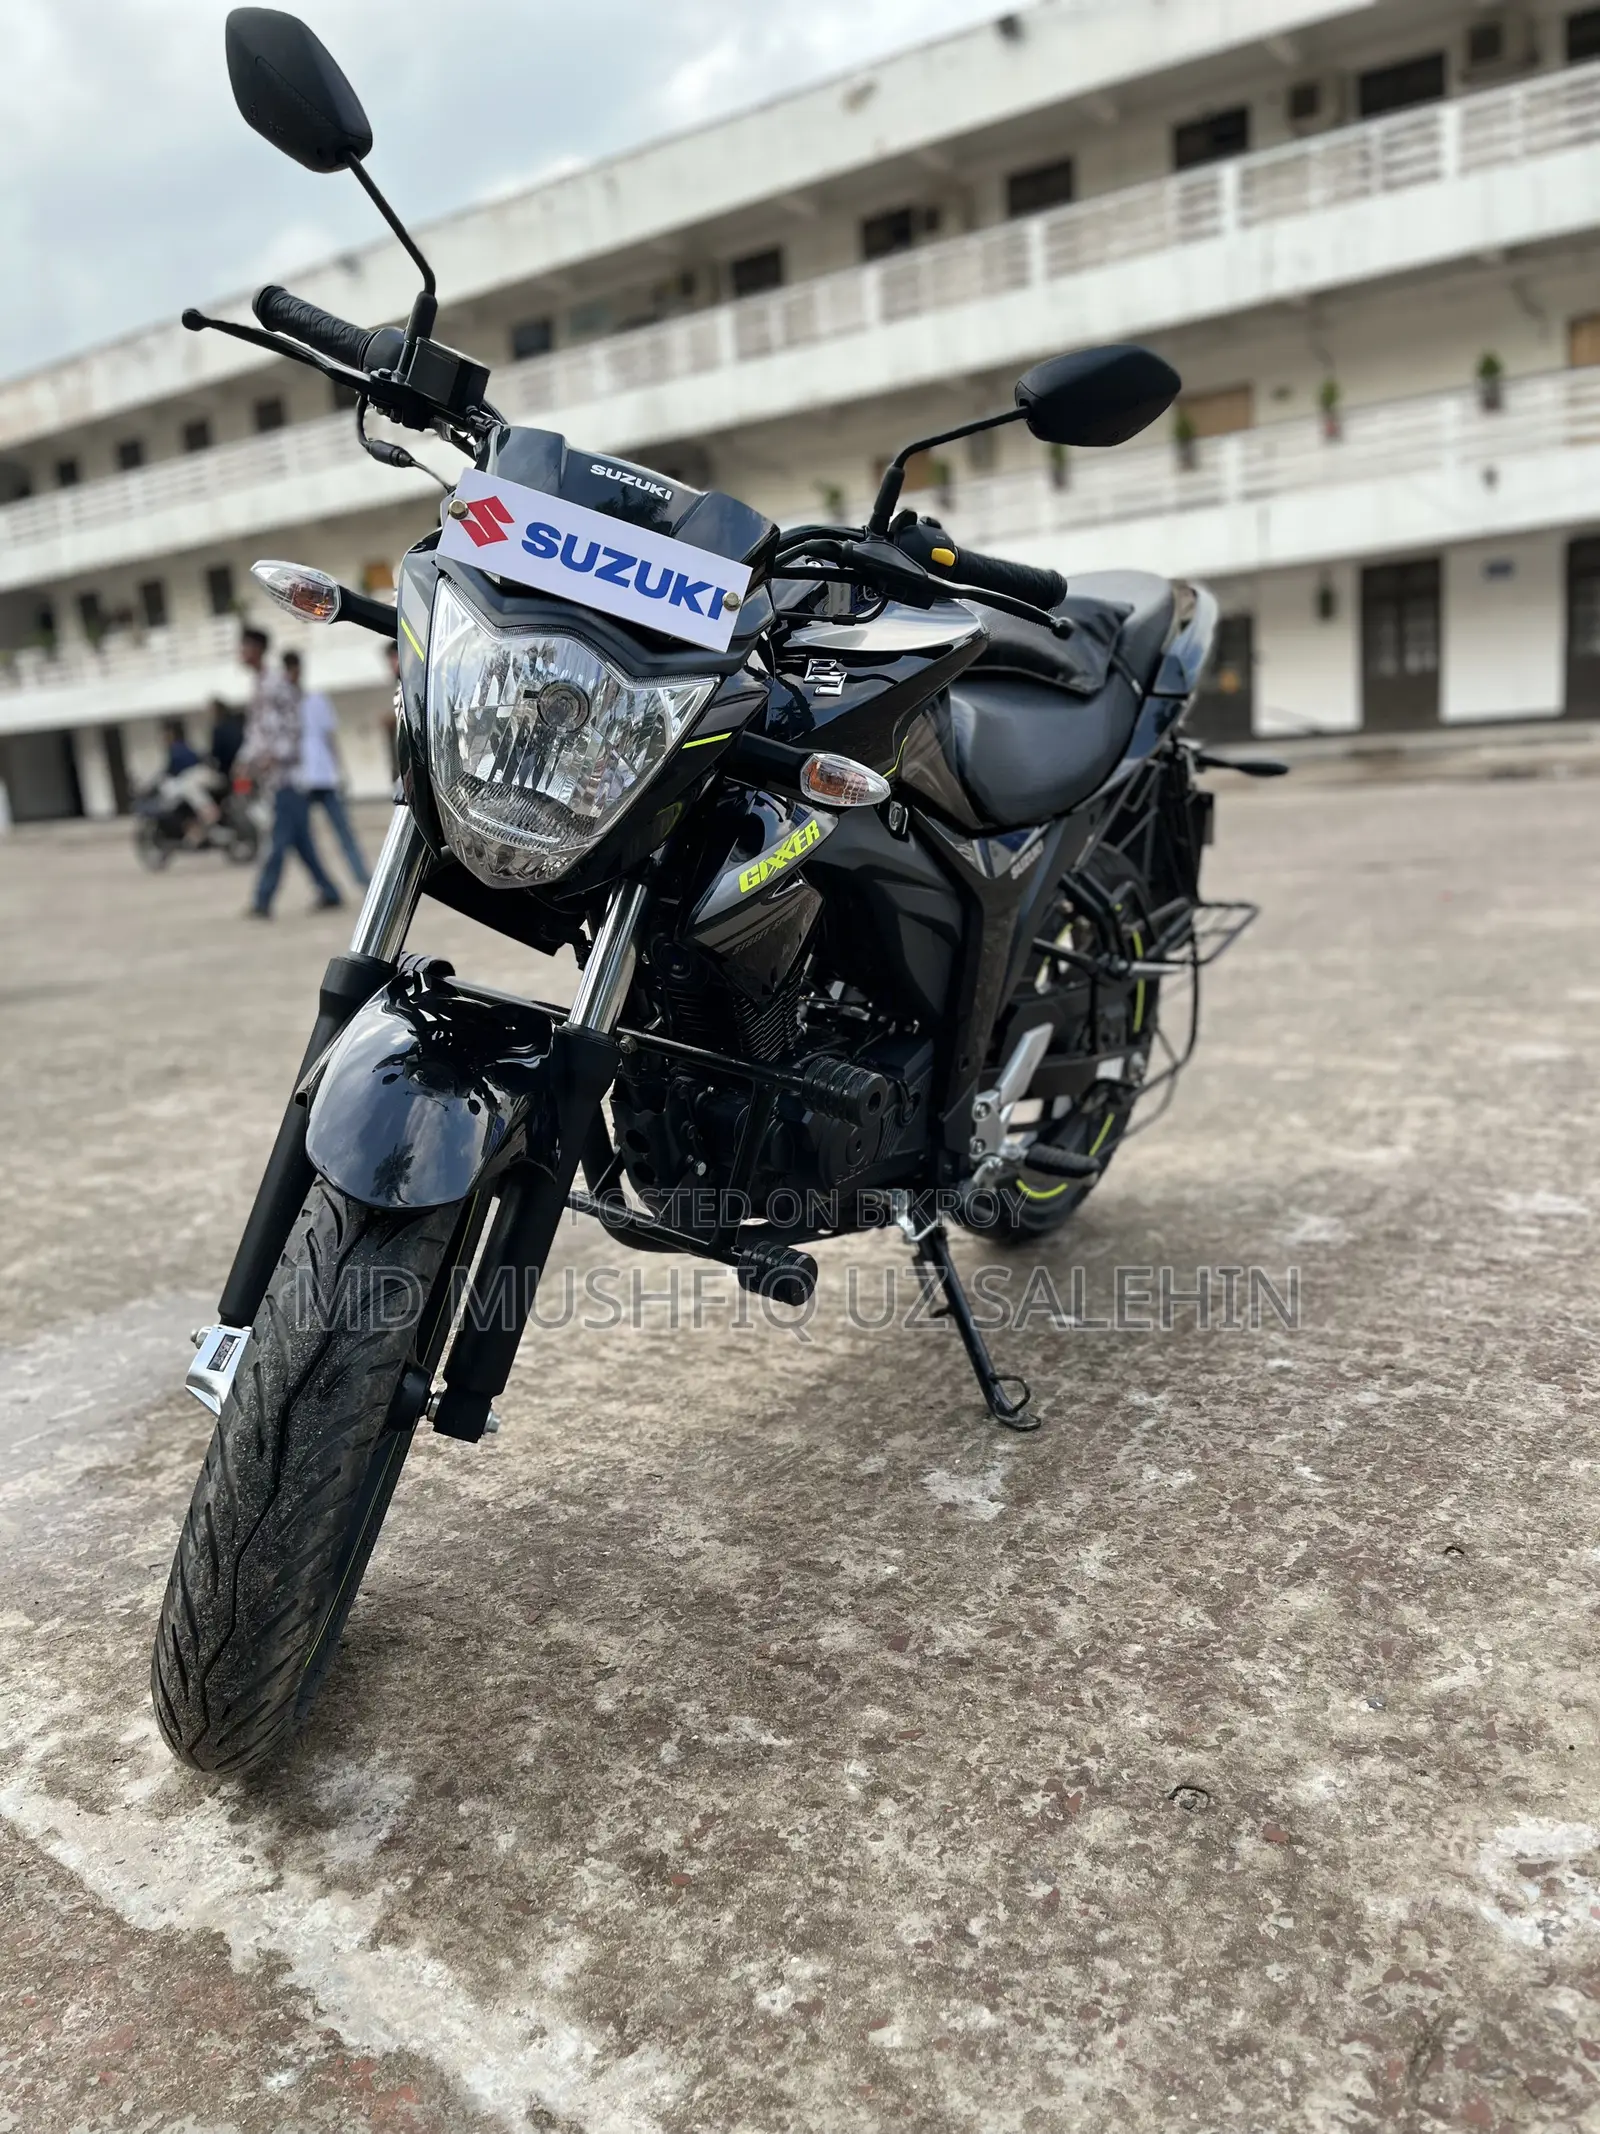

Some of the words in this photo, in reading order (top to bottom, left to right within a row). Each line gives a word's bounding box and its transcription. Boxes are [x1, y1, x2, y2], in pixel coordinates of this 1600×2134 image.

[590, 464, 673, 501] SUZUKI
[521, 521, 729, 621] SUZUKI
[738, 819, 821, 893] GIXXER
